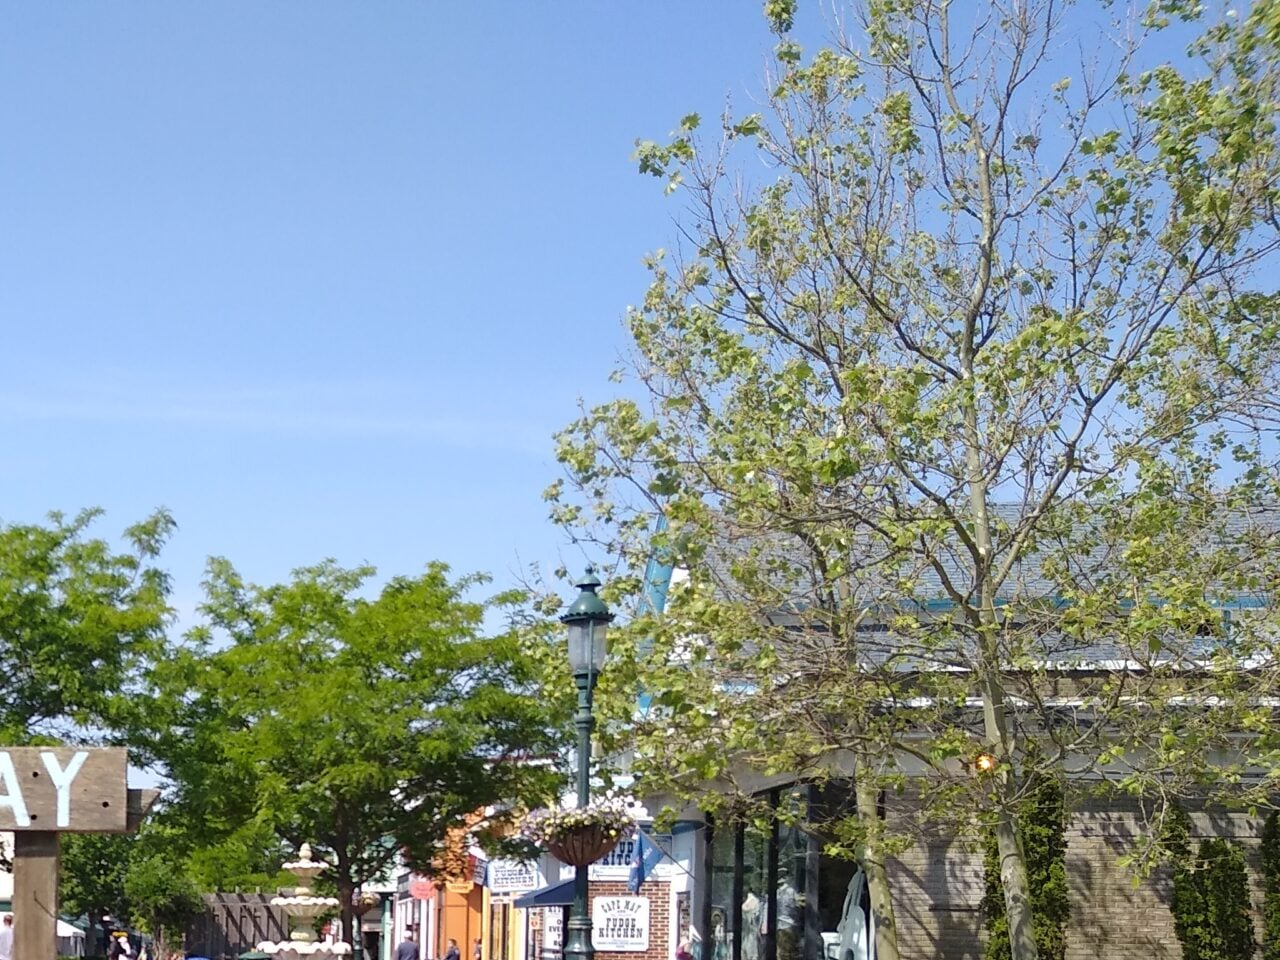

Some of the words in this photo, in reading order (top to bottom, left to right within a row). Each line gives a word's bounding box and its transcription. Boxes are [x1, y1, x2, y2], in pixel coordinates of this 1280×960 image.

[601, 899, 620, 914] CAPE
[624, 899, 642, 914] MAY
[606, 918, 636, 928] FUDGE
[599, 928, 643, 939] KITCHEN
